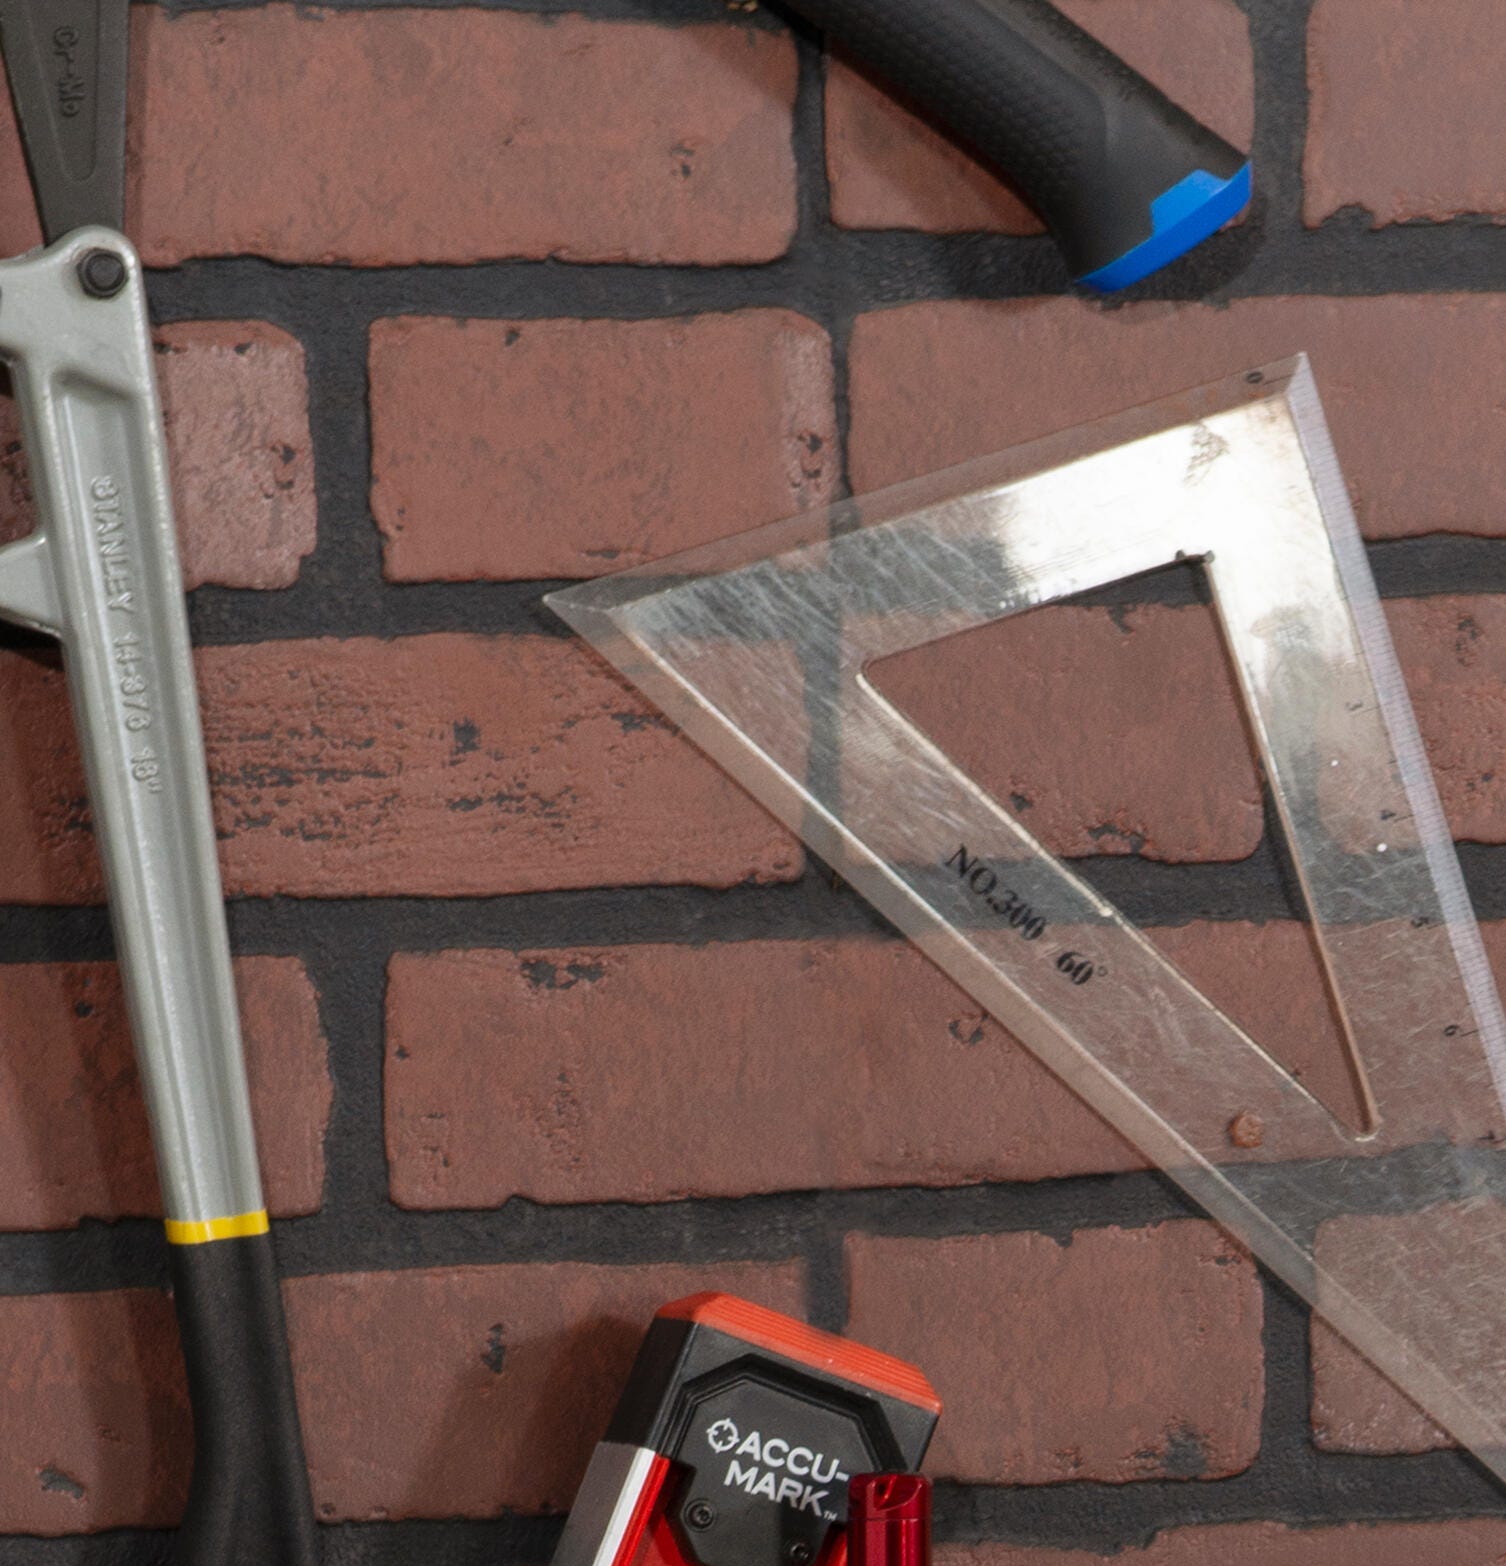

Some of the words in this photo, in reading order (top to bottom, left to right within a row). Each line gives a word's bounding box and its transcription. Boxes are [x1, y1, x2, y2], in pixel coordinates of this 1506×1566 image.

[90, 475, 134, 614] STANLEY
[944, 843, 1047, 941] NO.300
[724, 1460, 829, 1516] MARK
[736, 1431, 849, 1484] ACCU-
